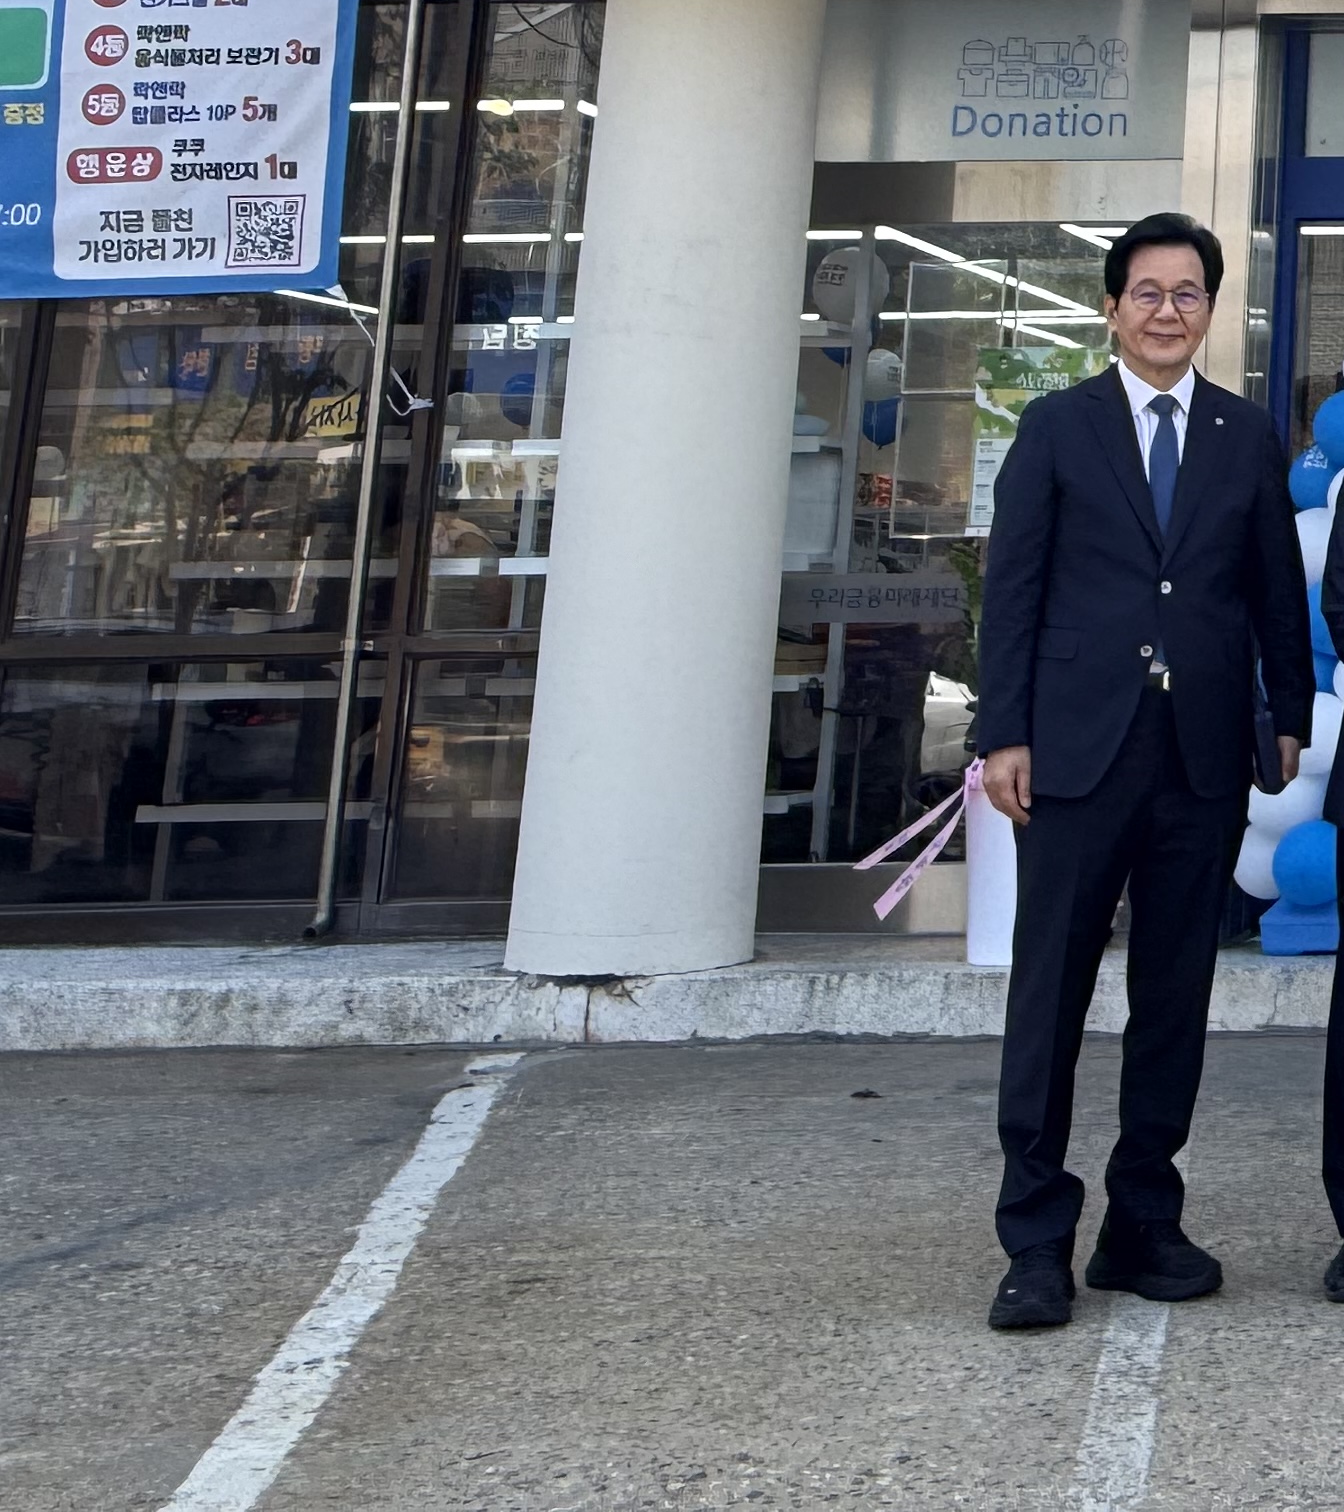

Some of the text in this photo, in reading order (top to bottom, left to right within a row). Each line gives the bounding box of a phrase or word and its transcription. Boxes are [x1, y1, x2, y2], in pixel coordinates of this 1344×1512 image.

[206, 103, 237, 122] 10P
[951, 104, 1129, 139] Donation
[99, 209, 145, 234] 지금
[78, 236, 217, 263] 가입하러 가기
